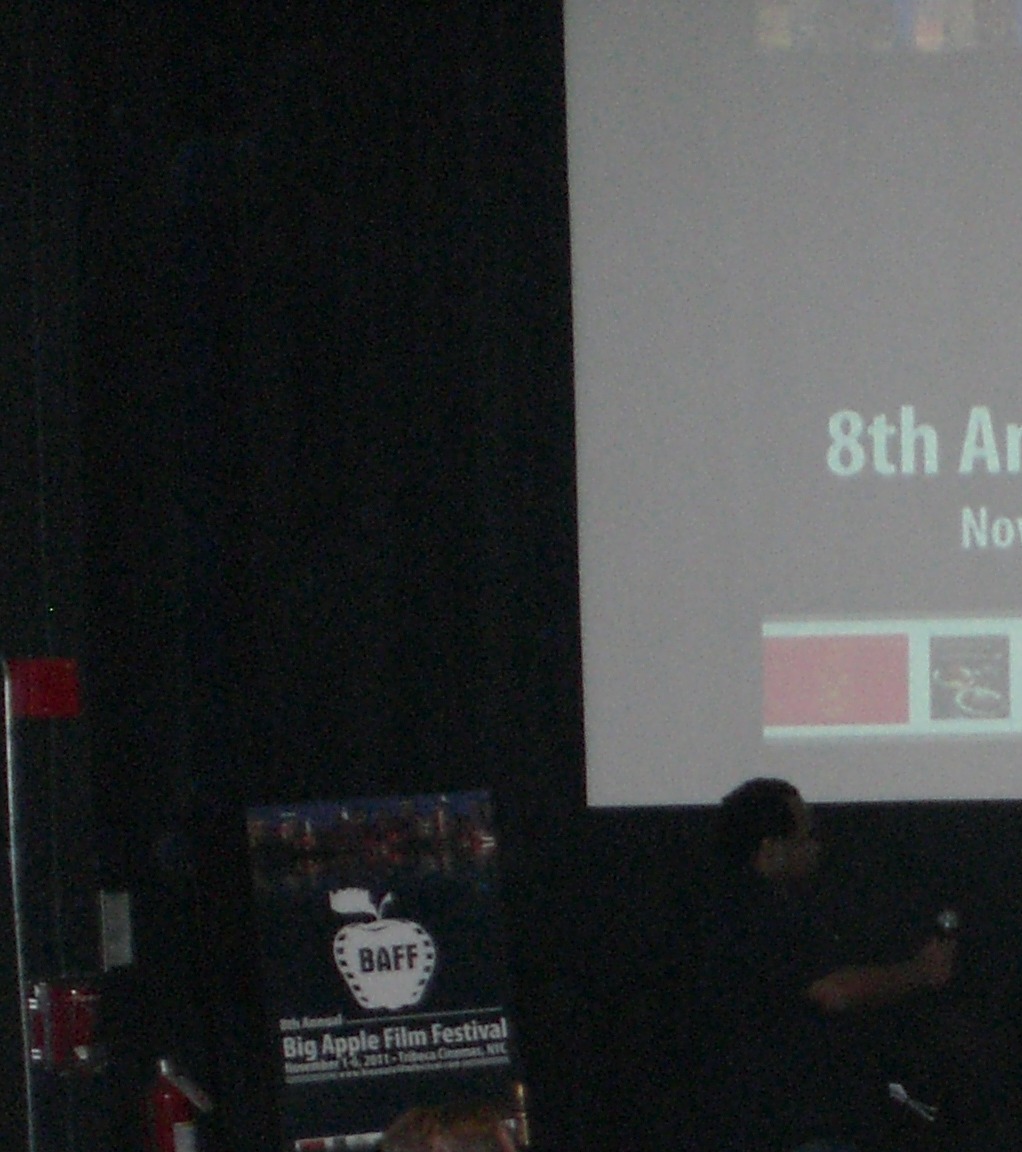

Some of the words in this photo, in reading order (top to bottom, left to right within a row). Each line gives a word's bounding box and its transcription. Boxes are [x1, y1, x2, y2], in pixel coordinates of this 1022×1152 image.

[826, 405, 939, 477] 8th
[358, 944, 419, 973] BAFF
[283, 1036, 317, 1061] Big
[322, 1029, 380, 1058] Apple
[383, 1026, 427, 1049] Film
[431, 1016, 508, 1044] Festival
